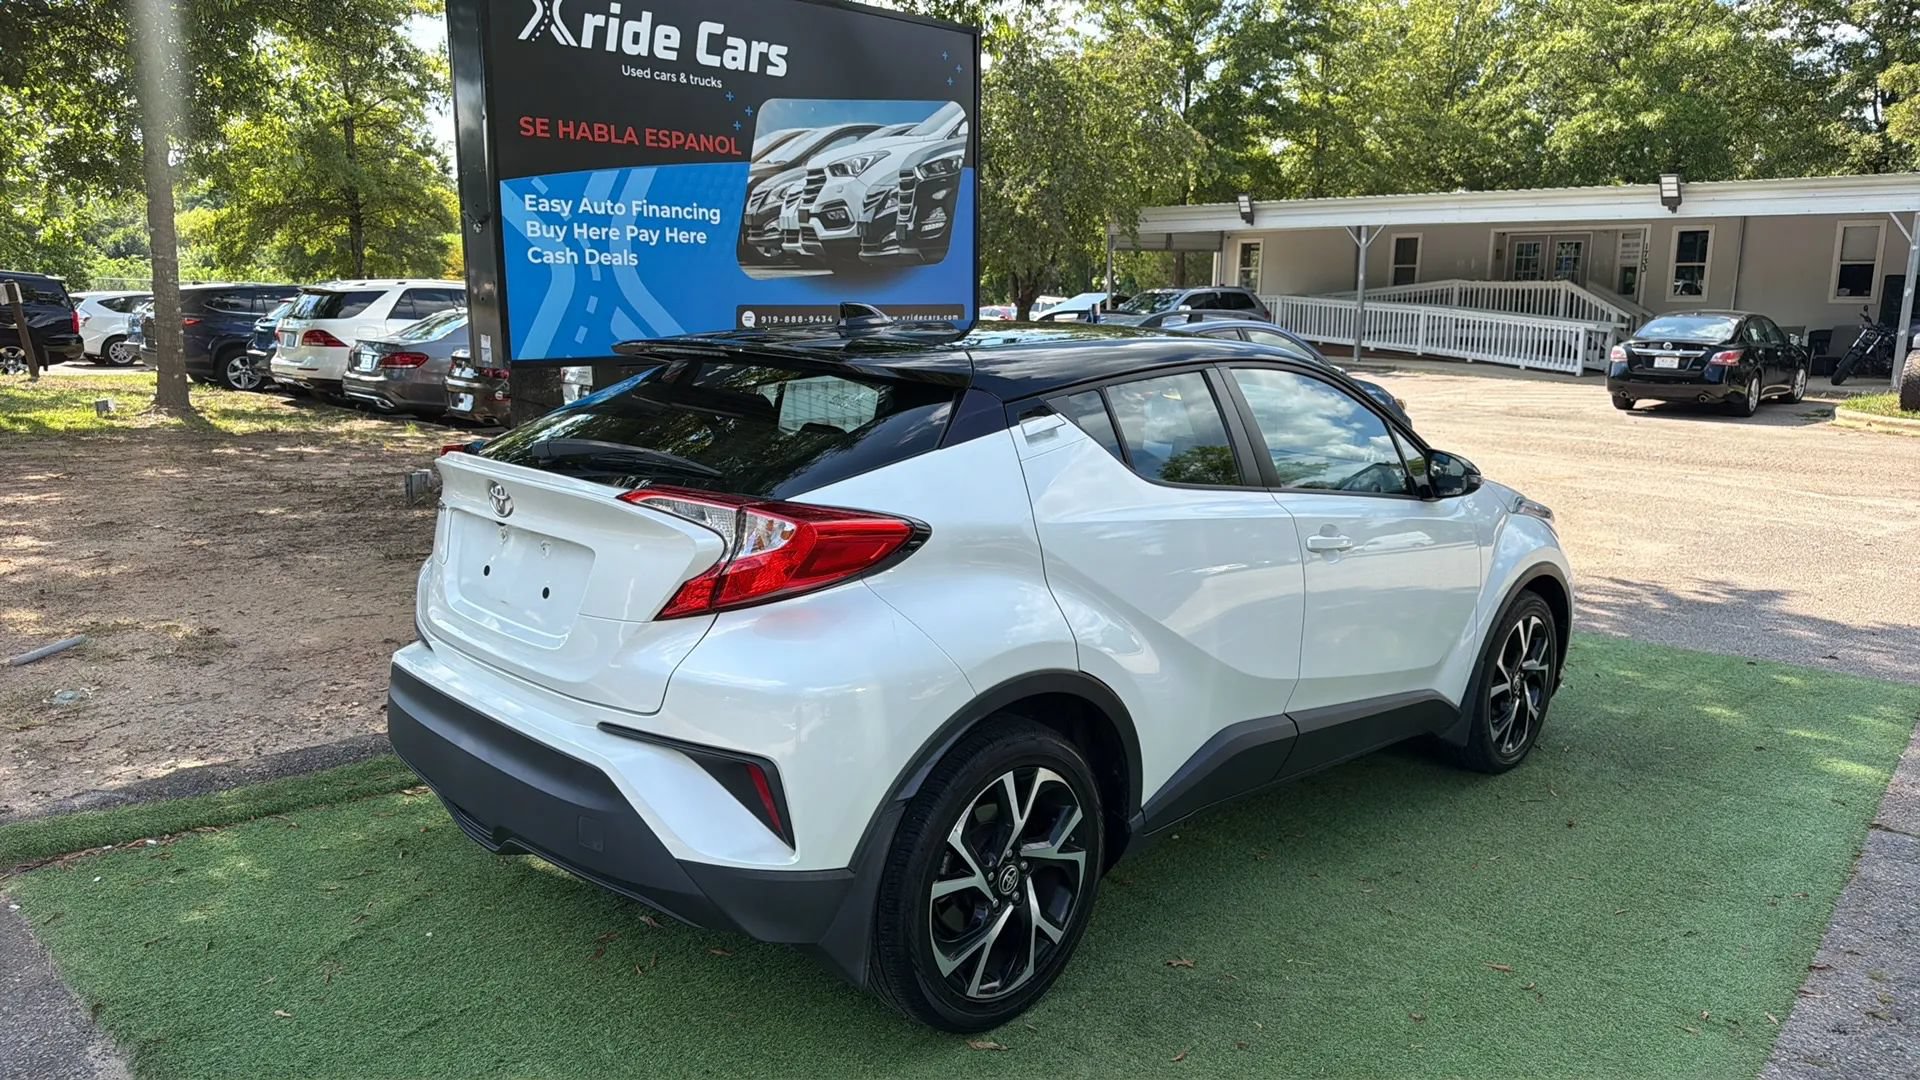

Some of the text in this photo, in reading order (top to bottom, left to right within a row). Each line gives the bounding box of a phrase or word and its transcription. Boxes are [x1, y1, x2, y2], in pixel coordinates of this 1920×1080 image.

[696, 21, 789, 77] Cars
[621, 64, 723, 89] Used cars & trucks
[519, 116, 742, 156] SE HABLA ESPANOL
[524, 194, 721, 225] Easy Auto Financing
[525, 221, 708, 246] Buy Here Pay Here
[527, 247, 639, 266] Cash Deals
[760, 314, 833, 324] 919-888-9434
